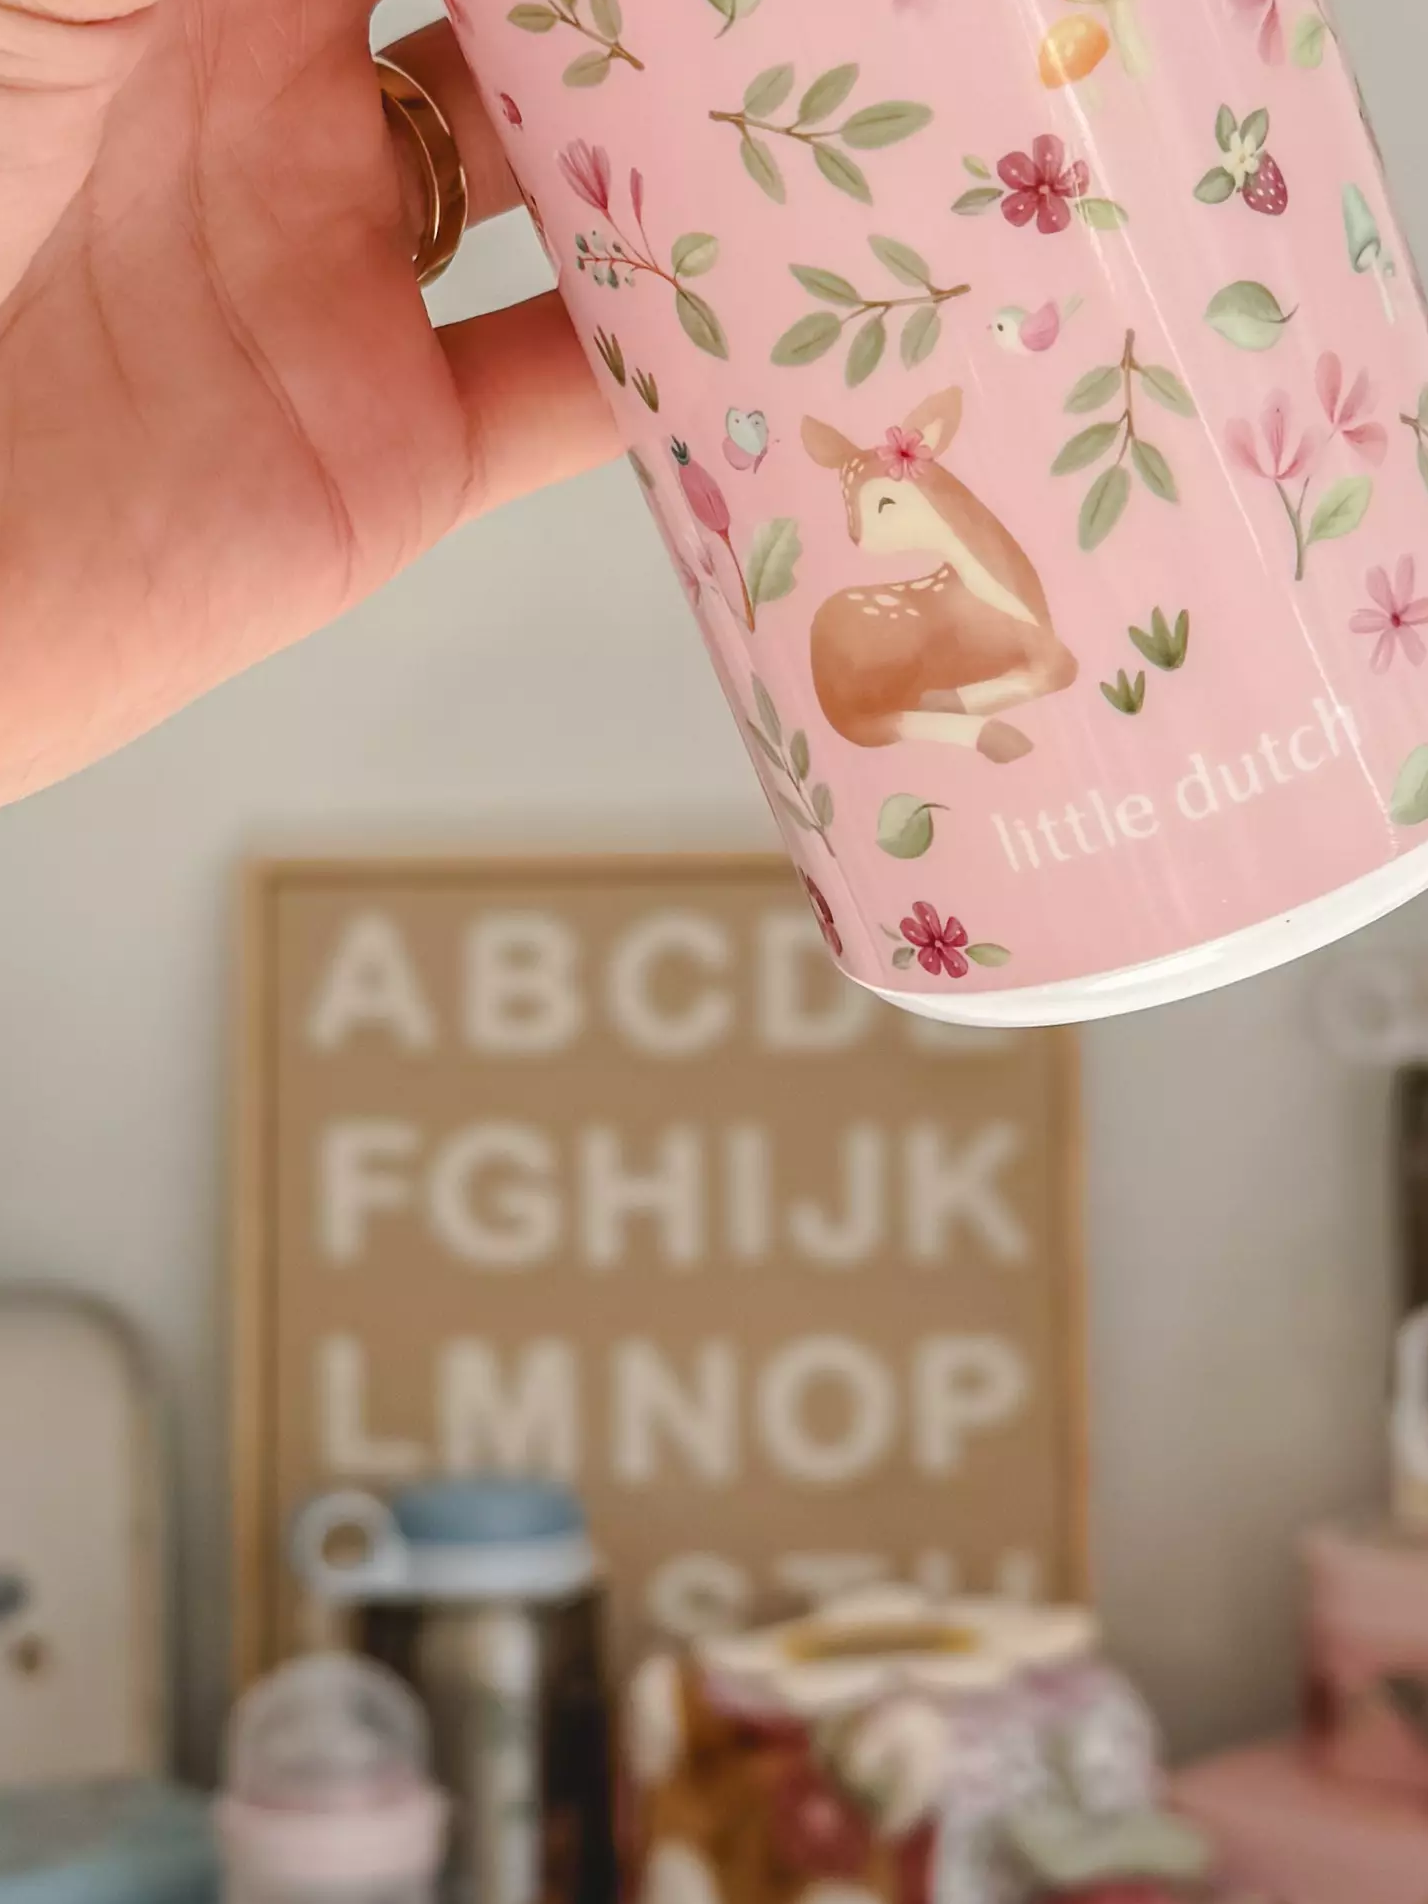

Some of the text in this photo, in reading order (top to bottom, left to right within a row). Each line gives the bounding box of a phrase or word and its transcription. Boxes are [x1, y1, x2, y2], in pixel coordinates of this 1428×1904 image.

[990, 696, 1362, 873] little dutch
[308, 908, 1012, 1054] ABCD
[320, 1120, 1030, 1266] FGHIJK
[316, 1332, 1030, 1486] LMNOP
